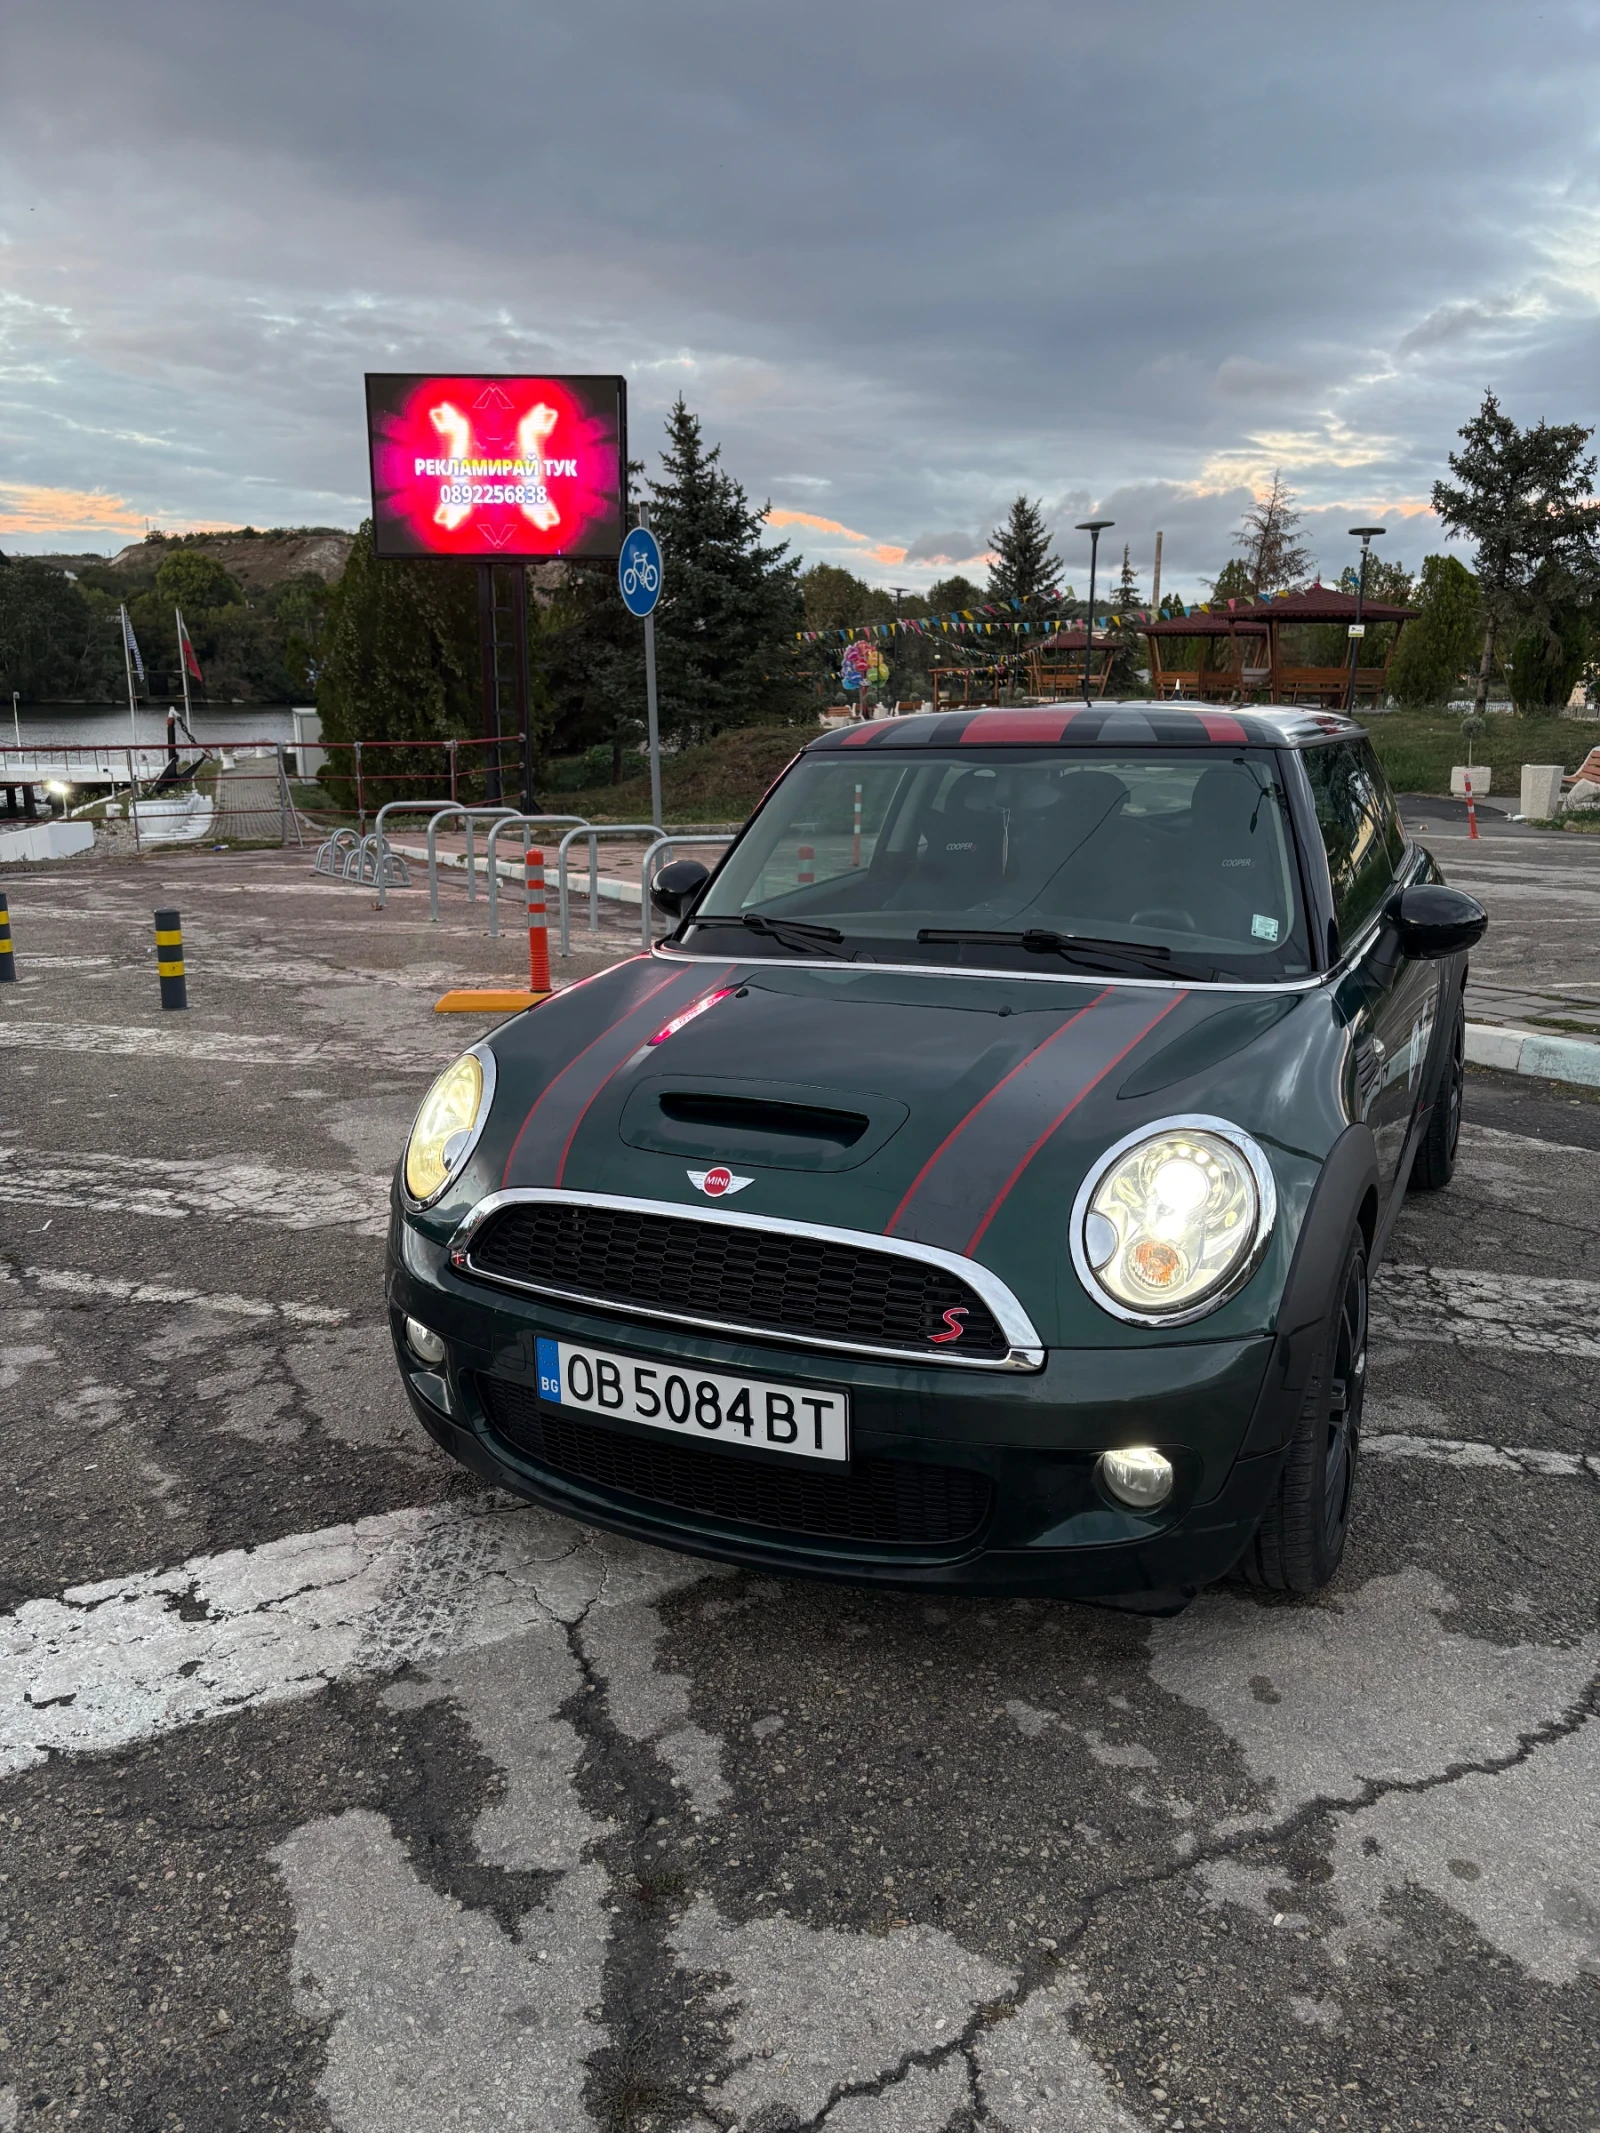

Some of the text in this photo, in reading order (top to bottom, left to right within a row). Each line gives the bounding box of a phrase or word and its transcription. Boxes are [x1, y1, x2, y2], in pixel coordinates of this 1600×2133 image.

[414, 454, 578, 477] РЕКЛАМИРАЙ ТУК
[440, 484, 547, 504] 0892256838
[946, 842, 973, 851] COOPER
[1221, 858, 1252, 867] COOPER
[705, 1176, 729, 1187] MINI
[927, 1307, 969, 1343] S
[540, 1376, 559, 1393] BG
